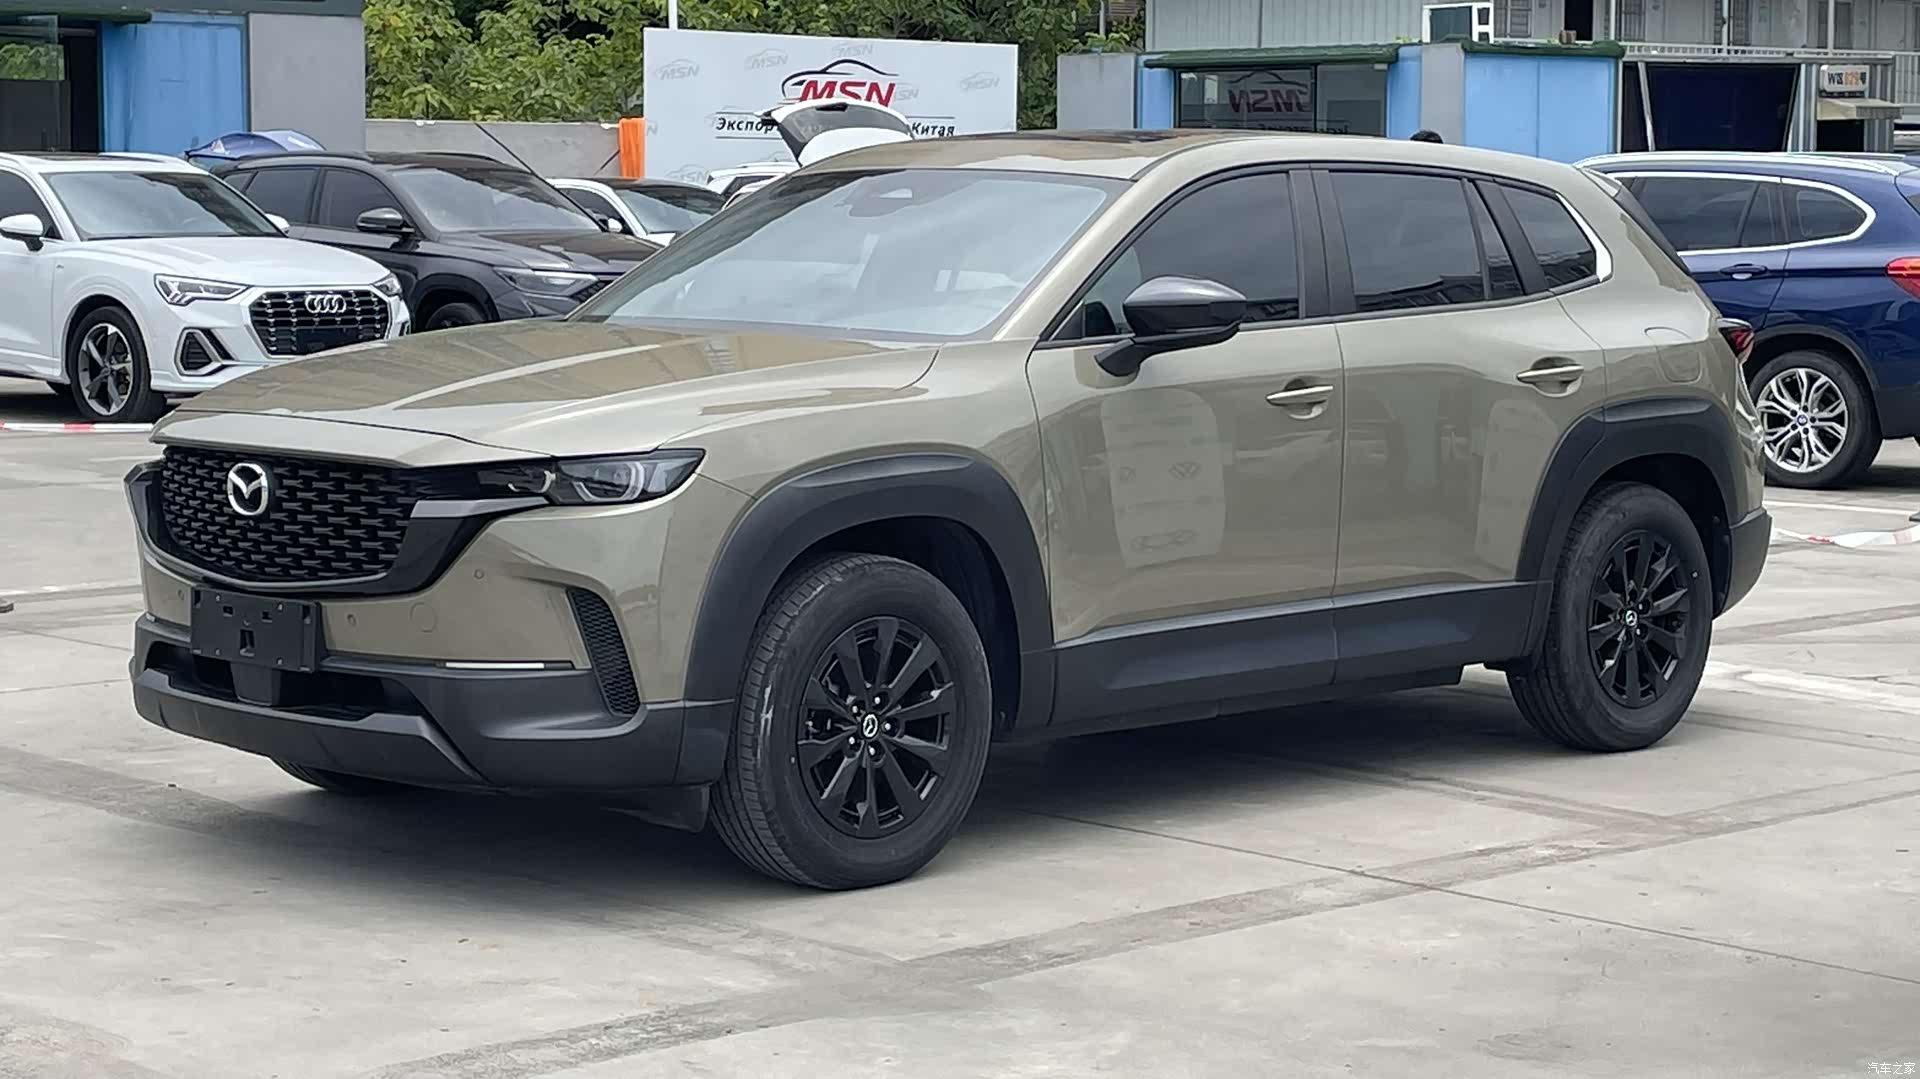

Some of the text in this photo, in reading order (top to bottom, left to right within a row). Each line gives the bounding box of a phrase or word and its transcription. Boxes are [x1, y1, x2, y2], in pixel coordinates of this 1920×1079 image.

[750, 55, 788, 70] MSN
[660, 66, 700, 80] MSN
[799, 79, 896, 108] MSN
[894, 88, 919, 101] SN
[715, 116, 777, 134] Экспор
[911, 122, 955, 137] Китая
